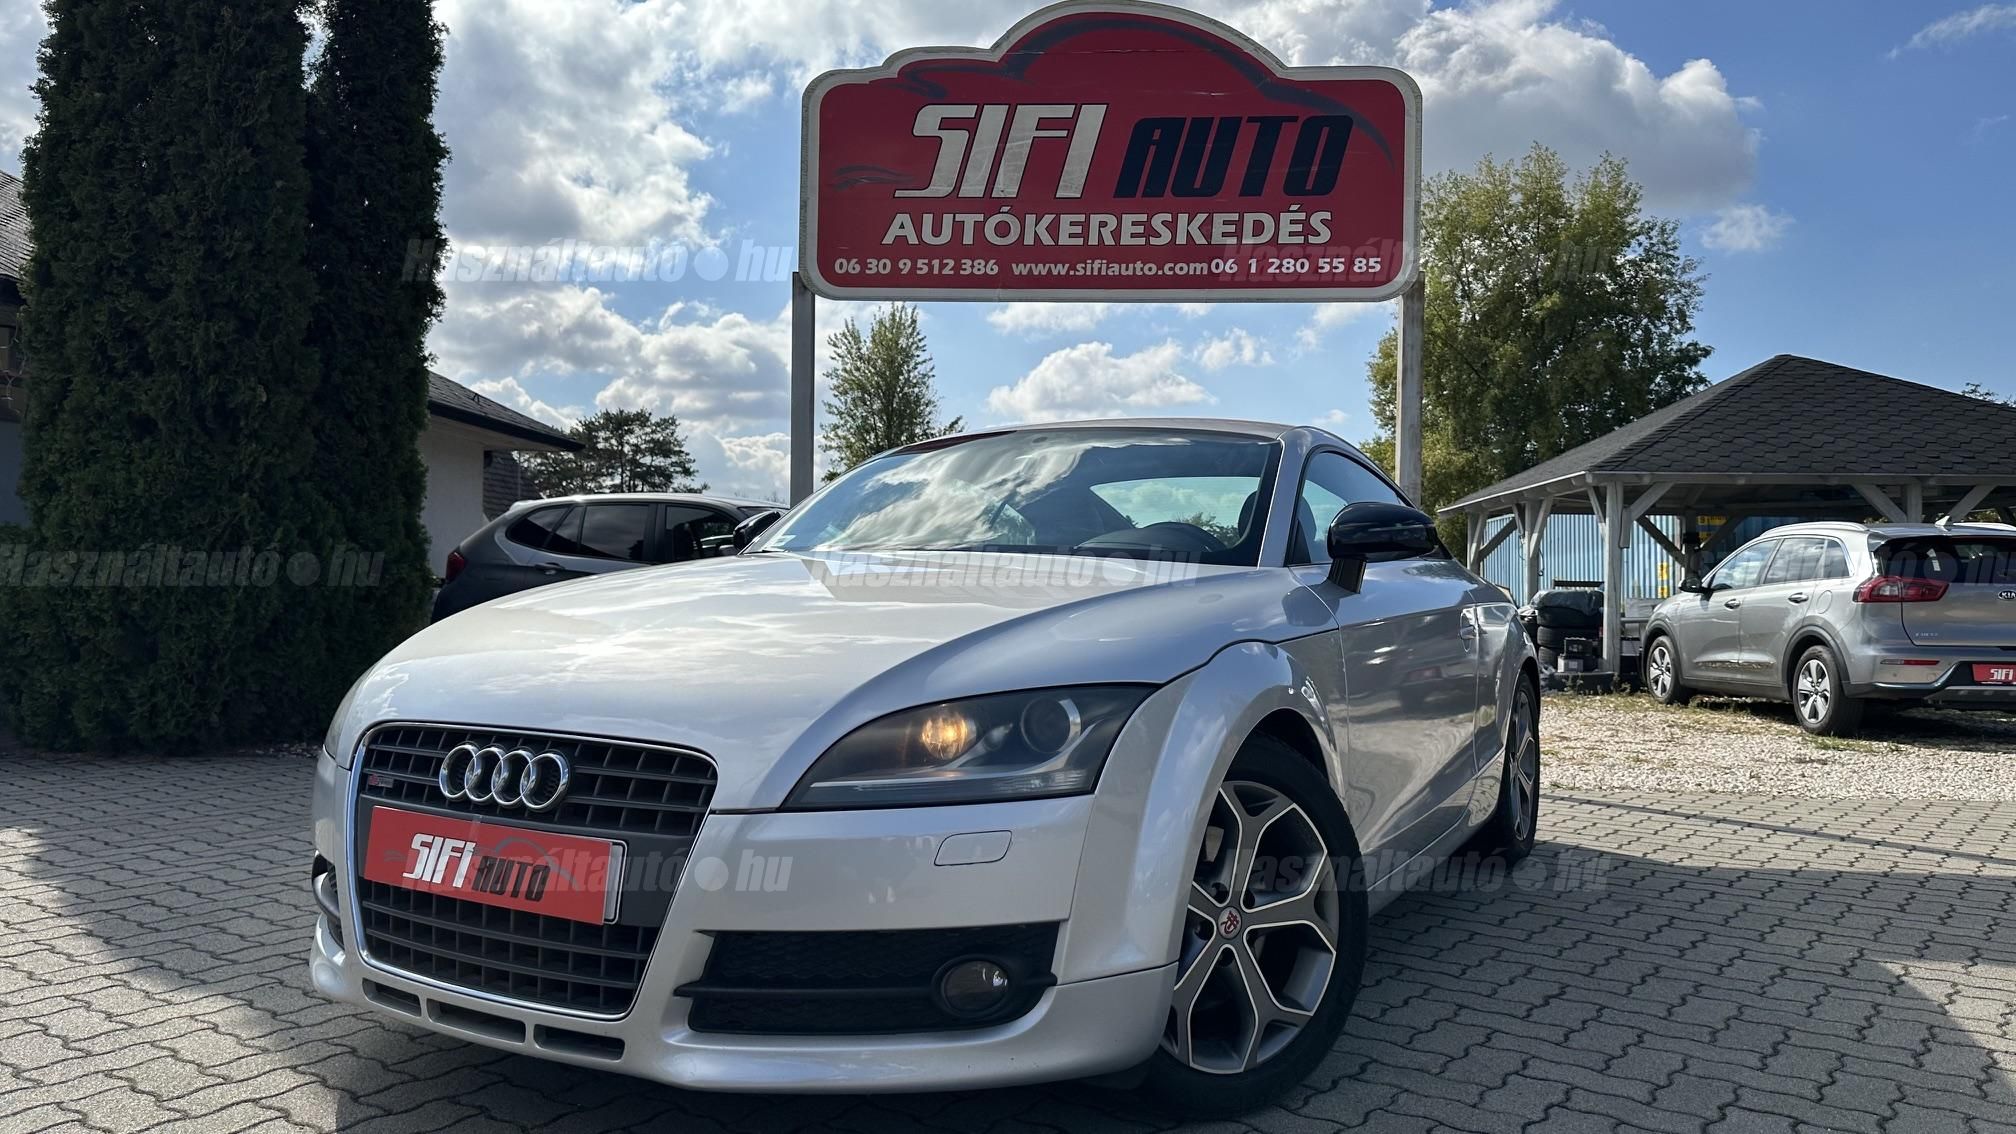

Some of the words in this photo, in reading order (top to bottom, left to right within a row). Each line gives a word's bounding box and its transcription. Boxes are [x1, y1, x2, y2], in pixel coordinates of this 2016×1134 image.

[894, 103, 1108, 199] SIFI
[1112, 115, 1354, 199] AUTO
[881, 204, 1334, 247] AUTÓKERESKEDÉS
[834, 258, 861, 275] 06
[865, 258, 891, 275] 30
[898, 258, 912, 275] 9
[916, 258, 955, 275] 512
[960, 258, 999, 275] 386
[1011, 258, 1208, 276] www.sifiauto.com
[1210, 258, 1238, 274] 06
[1248, 258, 1257, 274] 1
[1267, 258, 1310, 274] 280
[1318, 258, 1345, 274] 55
[1353, 257, 1382, 273] 85
[2001, 590, 2016, 599] KIA
[1989, 668, 2014, 680] SIFI
[402, 832, 476, 888] SIFI
[471, 855, 551, 902] AUTO
